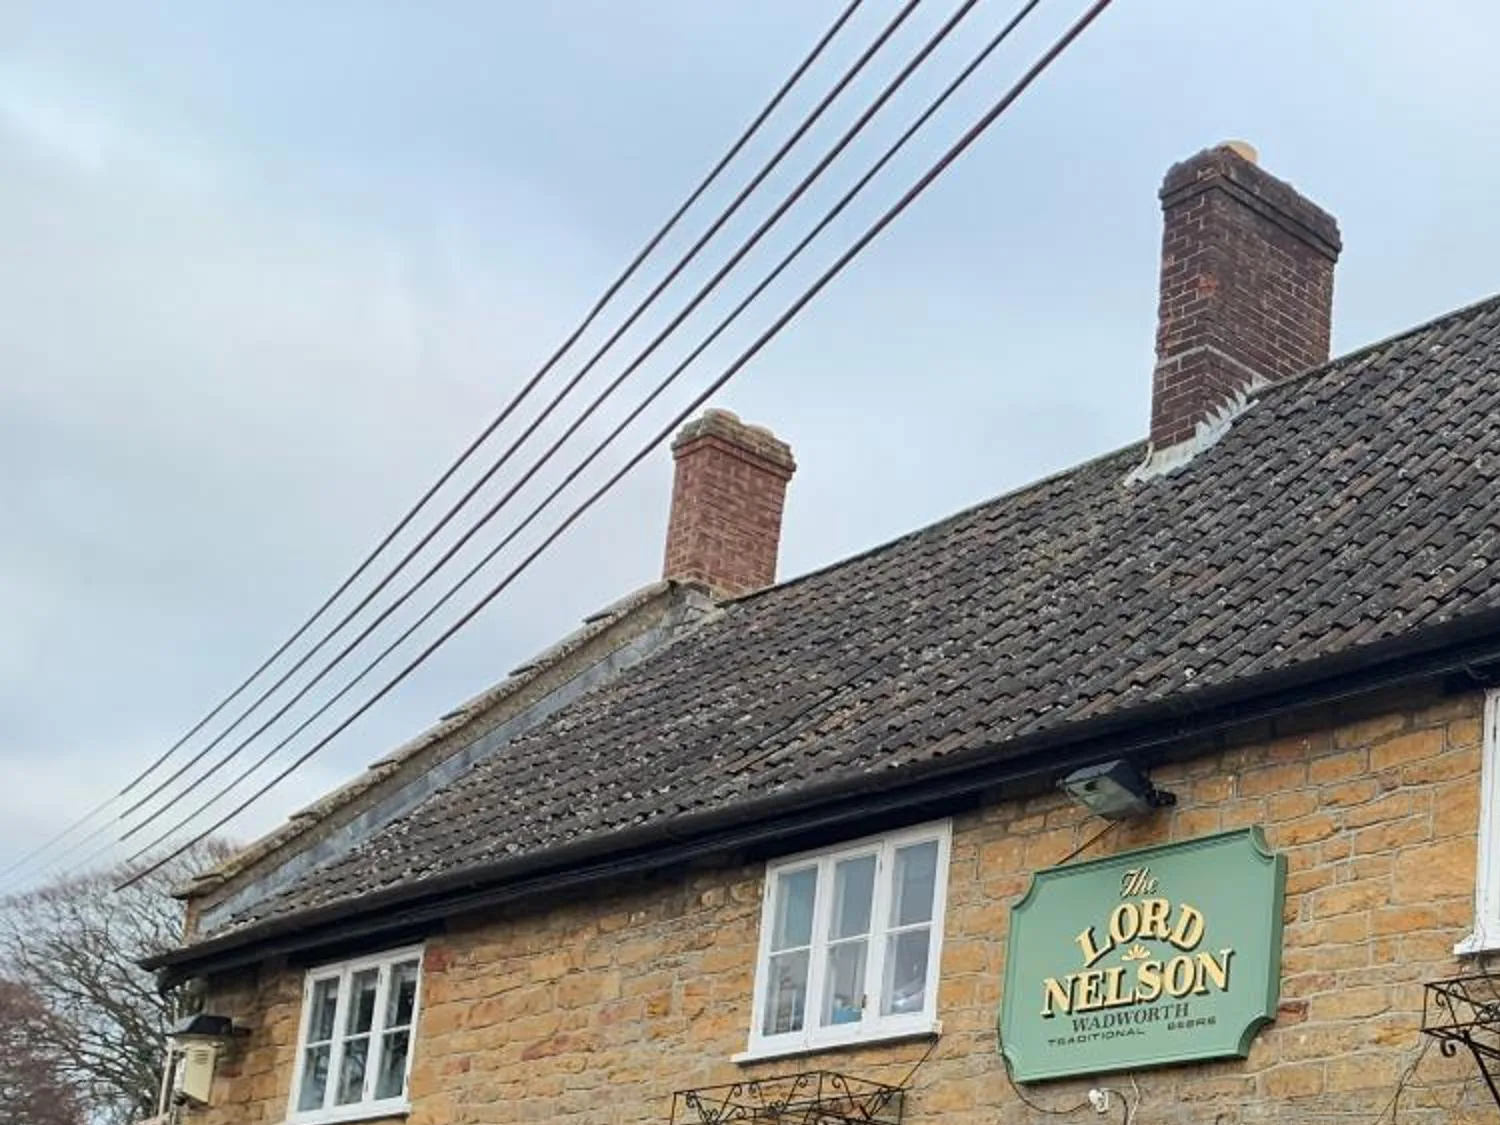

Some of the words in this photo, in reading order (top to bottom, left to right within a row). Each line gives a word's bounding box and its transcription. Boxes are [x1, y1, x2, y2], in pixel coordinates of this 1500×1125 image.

[1120, 867, 1159, 899] The
[1076, 898, 1207, 968] LORD
[1040, 949, 1236, 1018] NELSON
[1072, 1002, 1190, 1032] WADWORTH
[1048, 1028, 1145, 1047] TRADITIONAL
